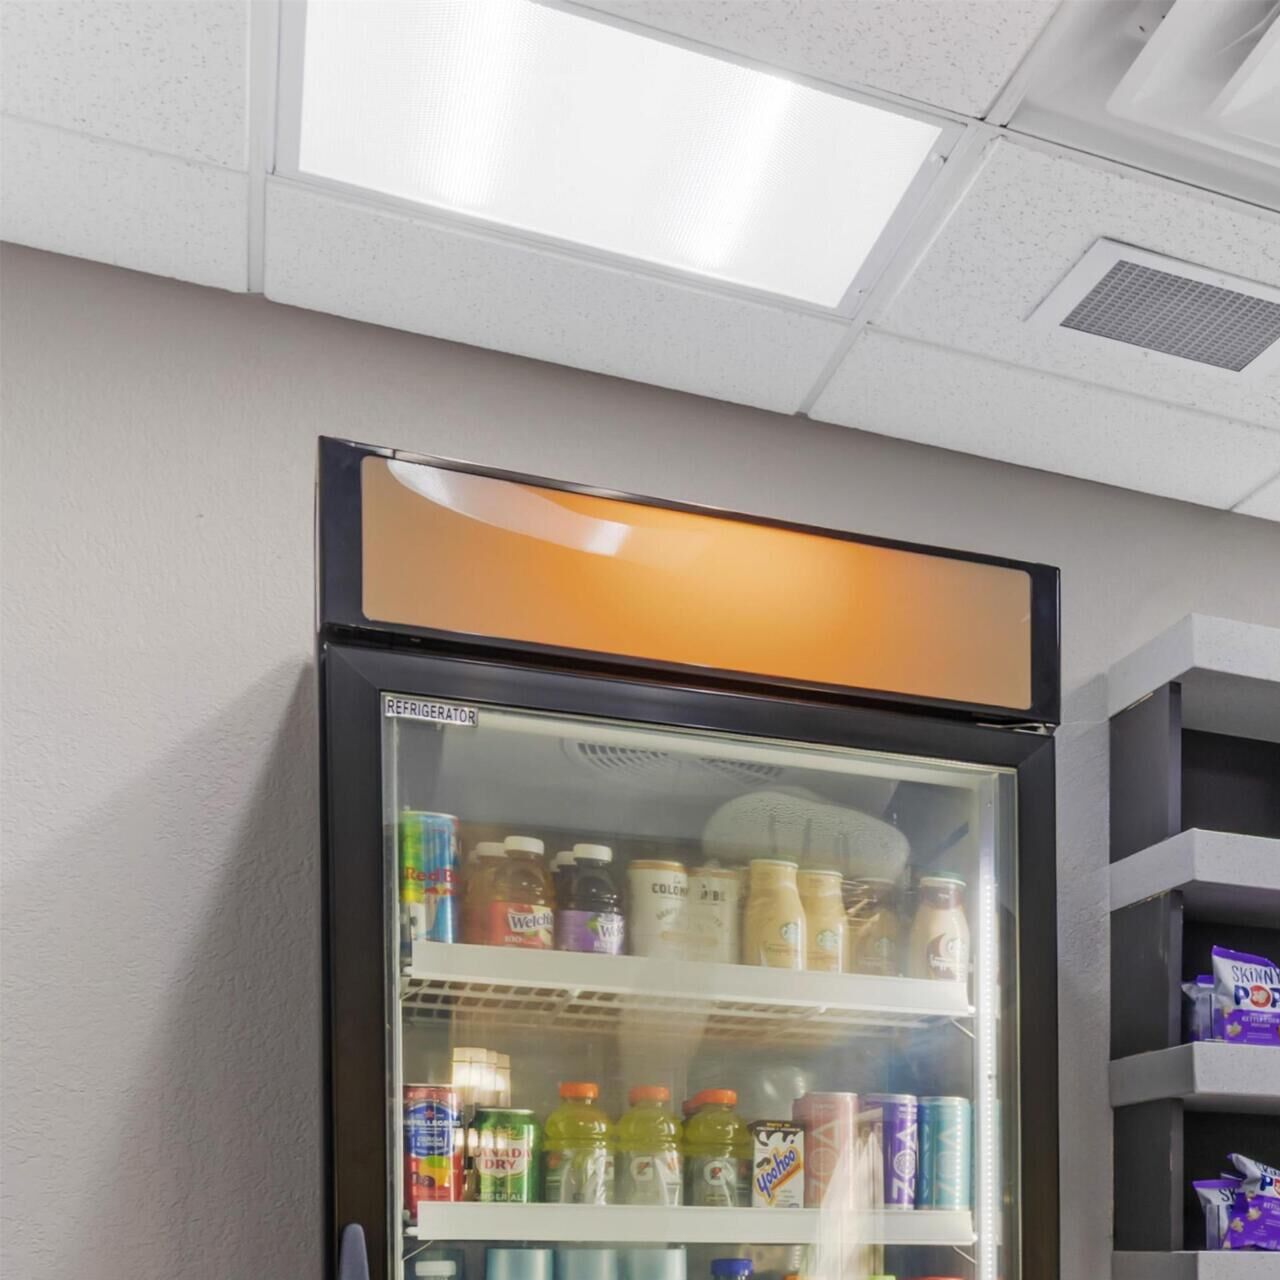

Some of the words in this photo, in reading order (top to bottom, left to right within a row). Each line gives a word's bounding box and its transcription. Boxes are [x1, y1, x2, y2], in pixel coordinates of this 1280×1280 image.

[386, 700, 476, 724] REFRIGERATOR
[405, 866, 439, 883] Red
[484, 1159, 518, 1171] DRY
[892, 1123, 917, 1199] ZOA
